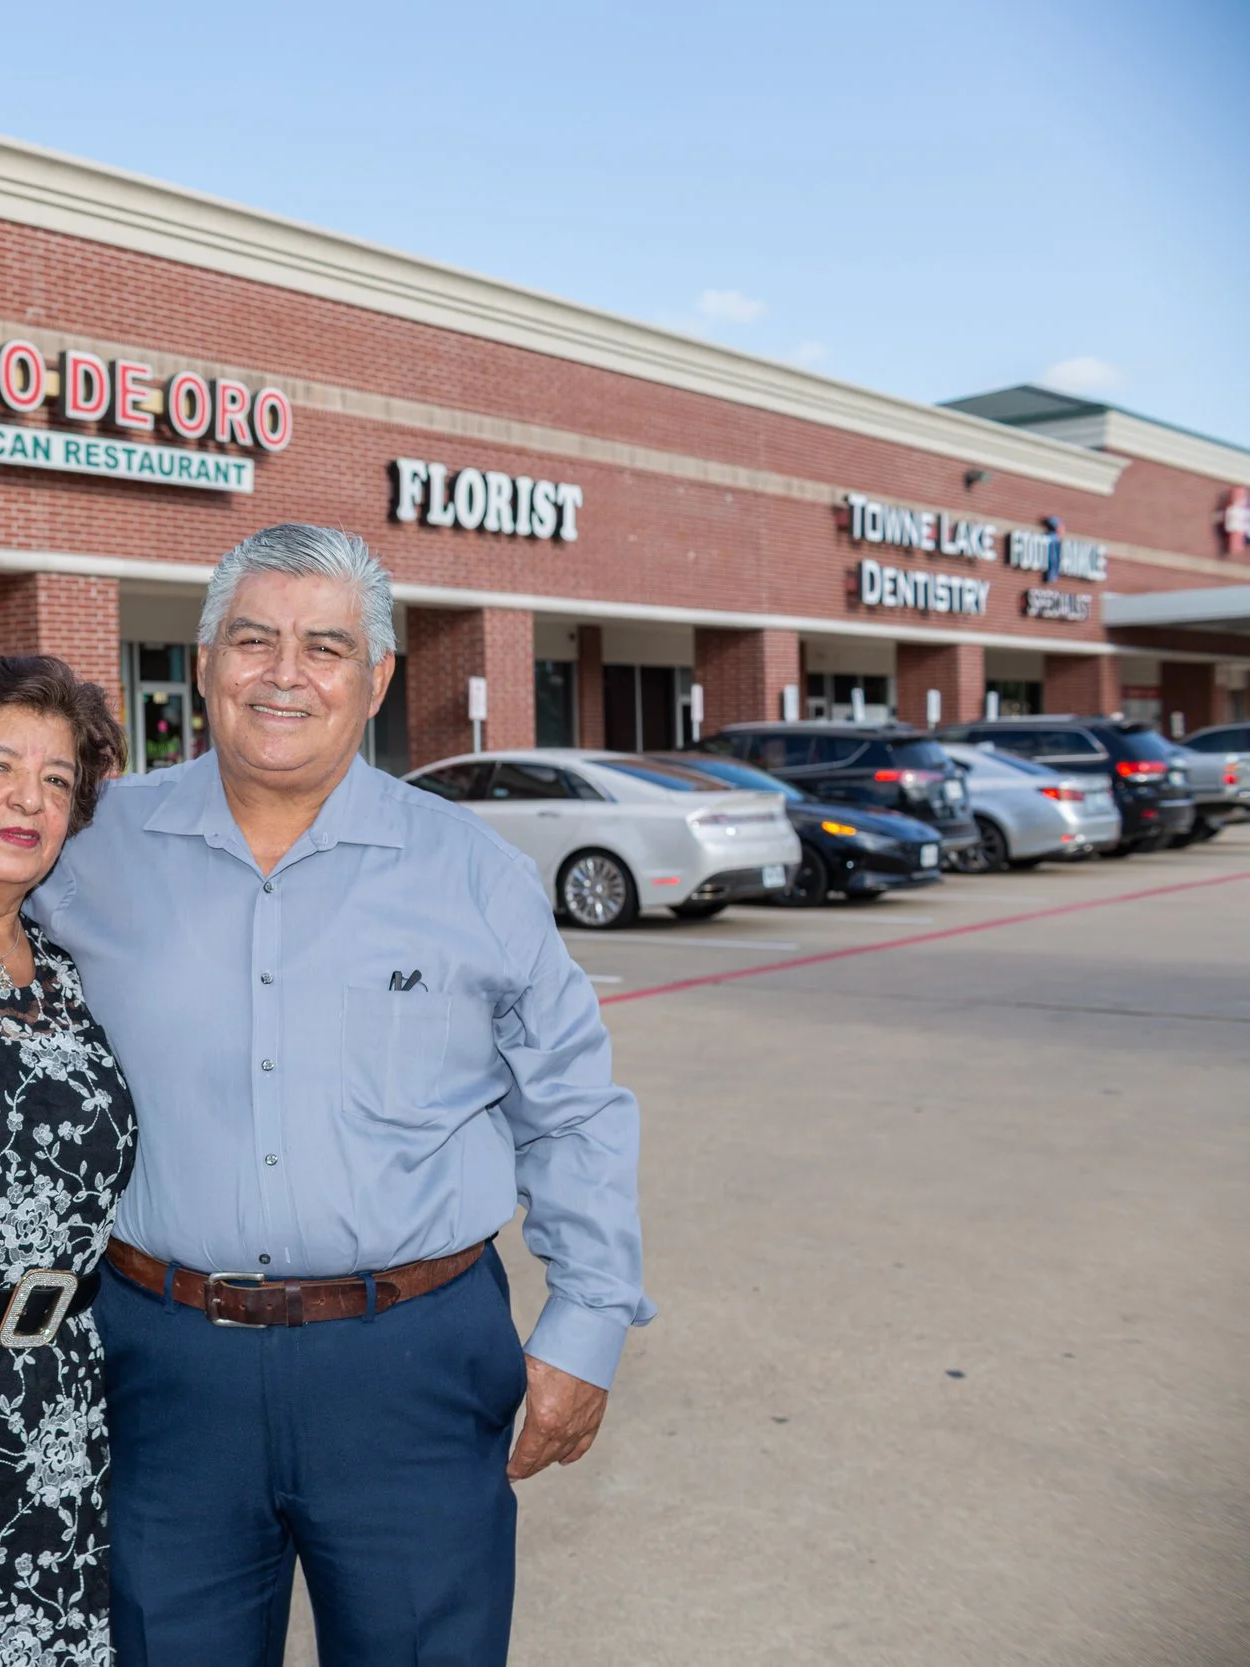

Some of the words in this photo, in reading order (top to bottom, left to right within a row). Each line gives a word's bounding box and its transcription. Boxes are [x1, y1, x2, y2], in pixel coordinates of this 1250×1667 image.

[65, 349, 155, 430] DE
[169, 371, 293, 452] ORO
[65, 441, 246, 485] RESTAURANT
[396, 457, 583, 541] FLORIST
[848, 493, 936, 551] TOWNE
[941, 512, 997, 561] LAKE
[861, 559, 991, 616] DENTISTRY
